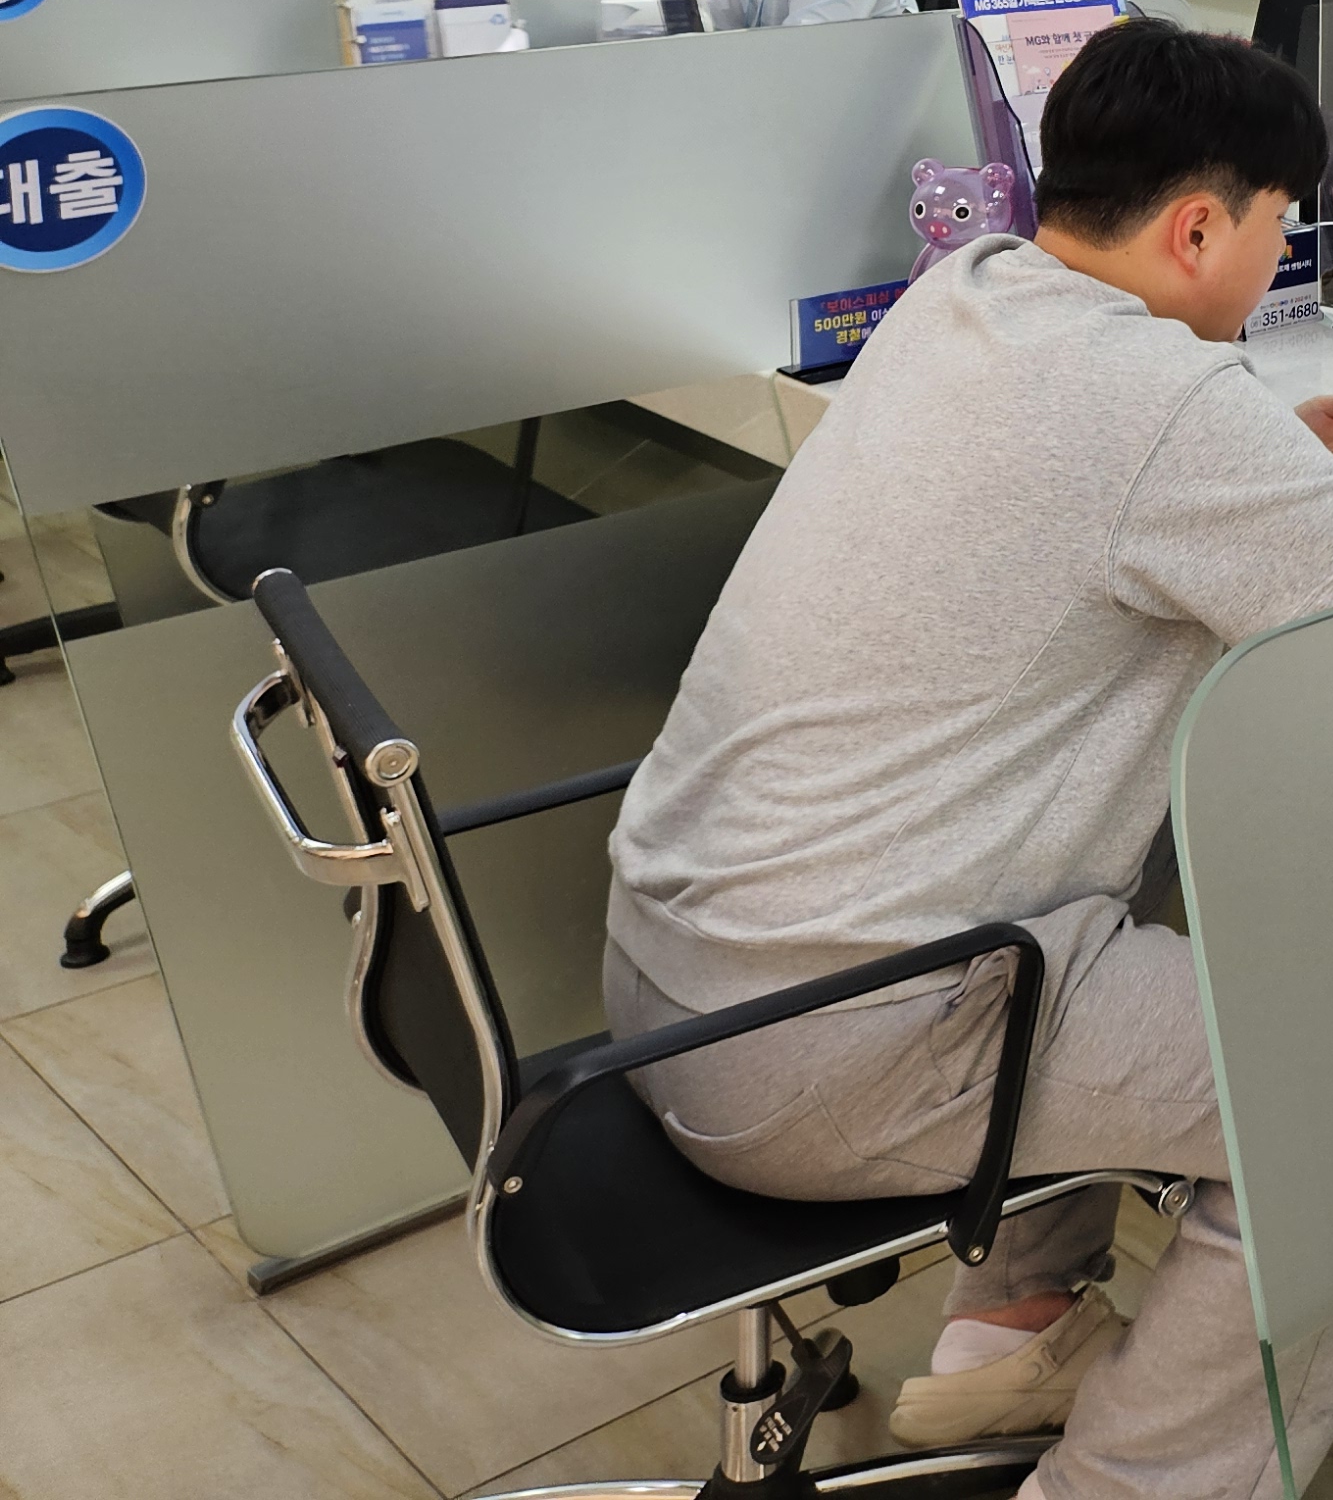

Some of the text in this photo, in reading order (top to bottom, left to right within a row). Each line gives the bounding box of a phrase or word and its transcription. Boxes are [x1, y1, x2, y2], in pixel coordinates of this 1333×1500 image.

[974, 0, 991, 11] MG
[0, 150, 123, 224] 대출
[814, 311, 867, 332] 500만원
[1262, 302, 1319, 327] 351-4680
